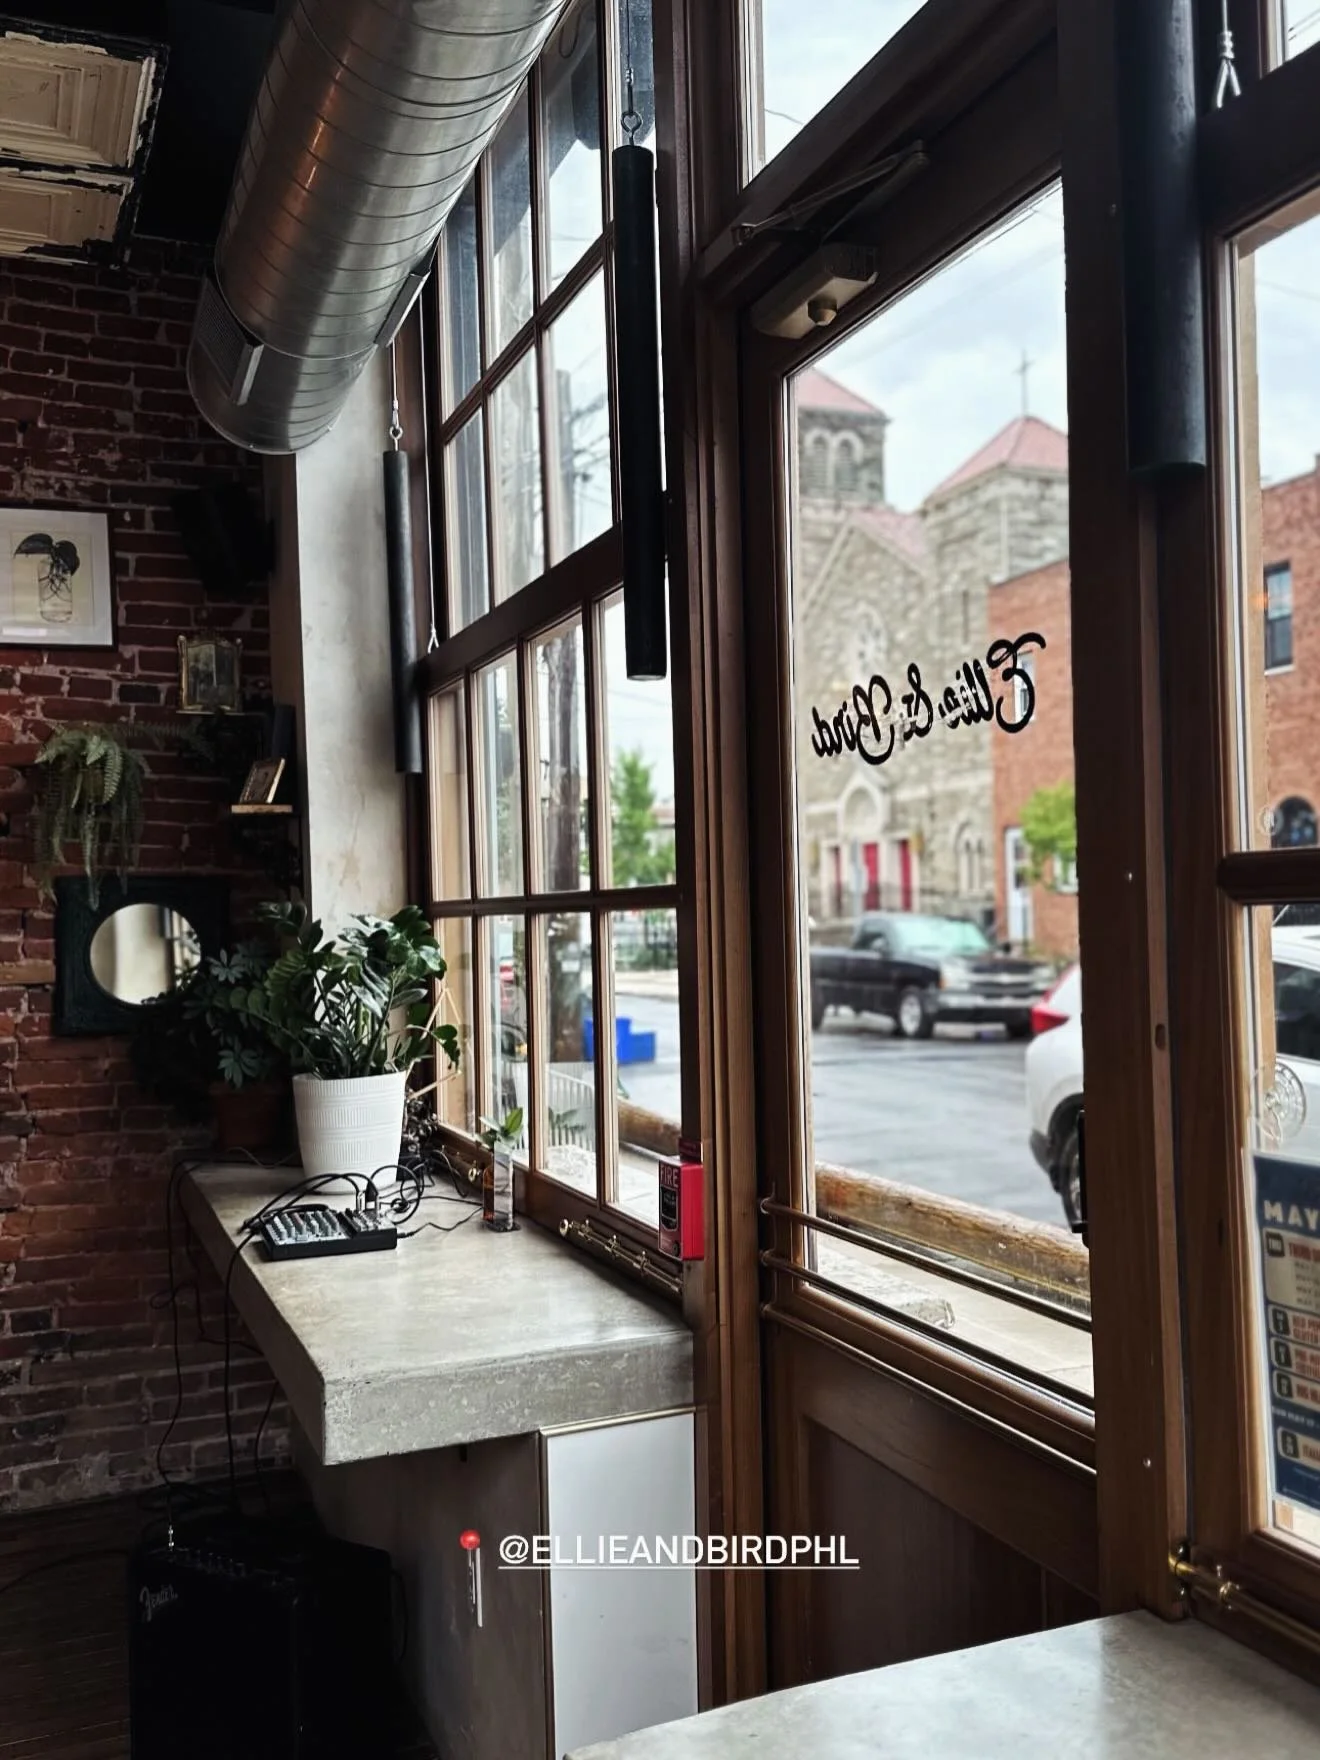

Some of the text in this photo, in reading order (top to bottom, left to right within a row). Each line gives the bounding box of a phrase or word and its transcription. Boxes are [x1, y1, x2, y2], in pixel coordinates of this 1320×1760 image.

[660, 1164, 679, 1188] FIRE
[1263, 1199, 1319, 1231] MAY
[139, 1584, 178, 1622] Fender
